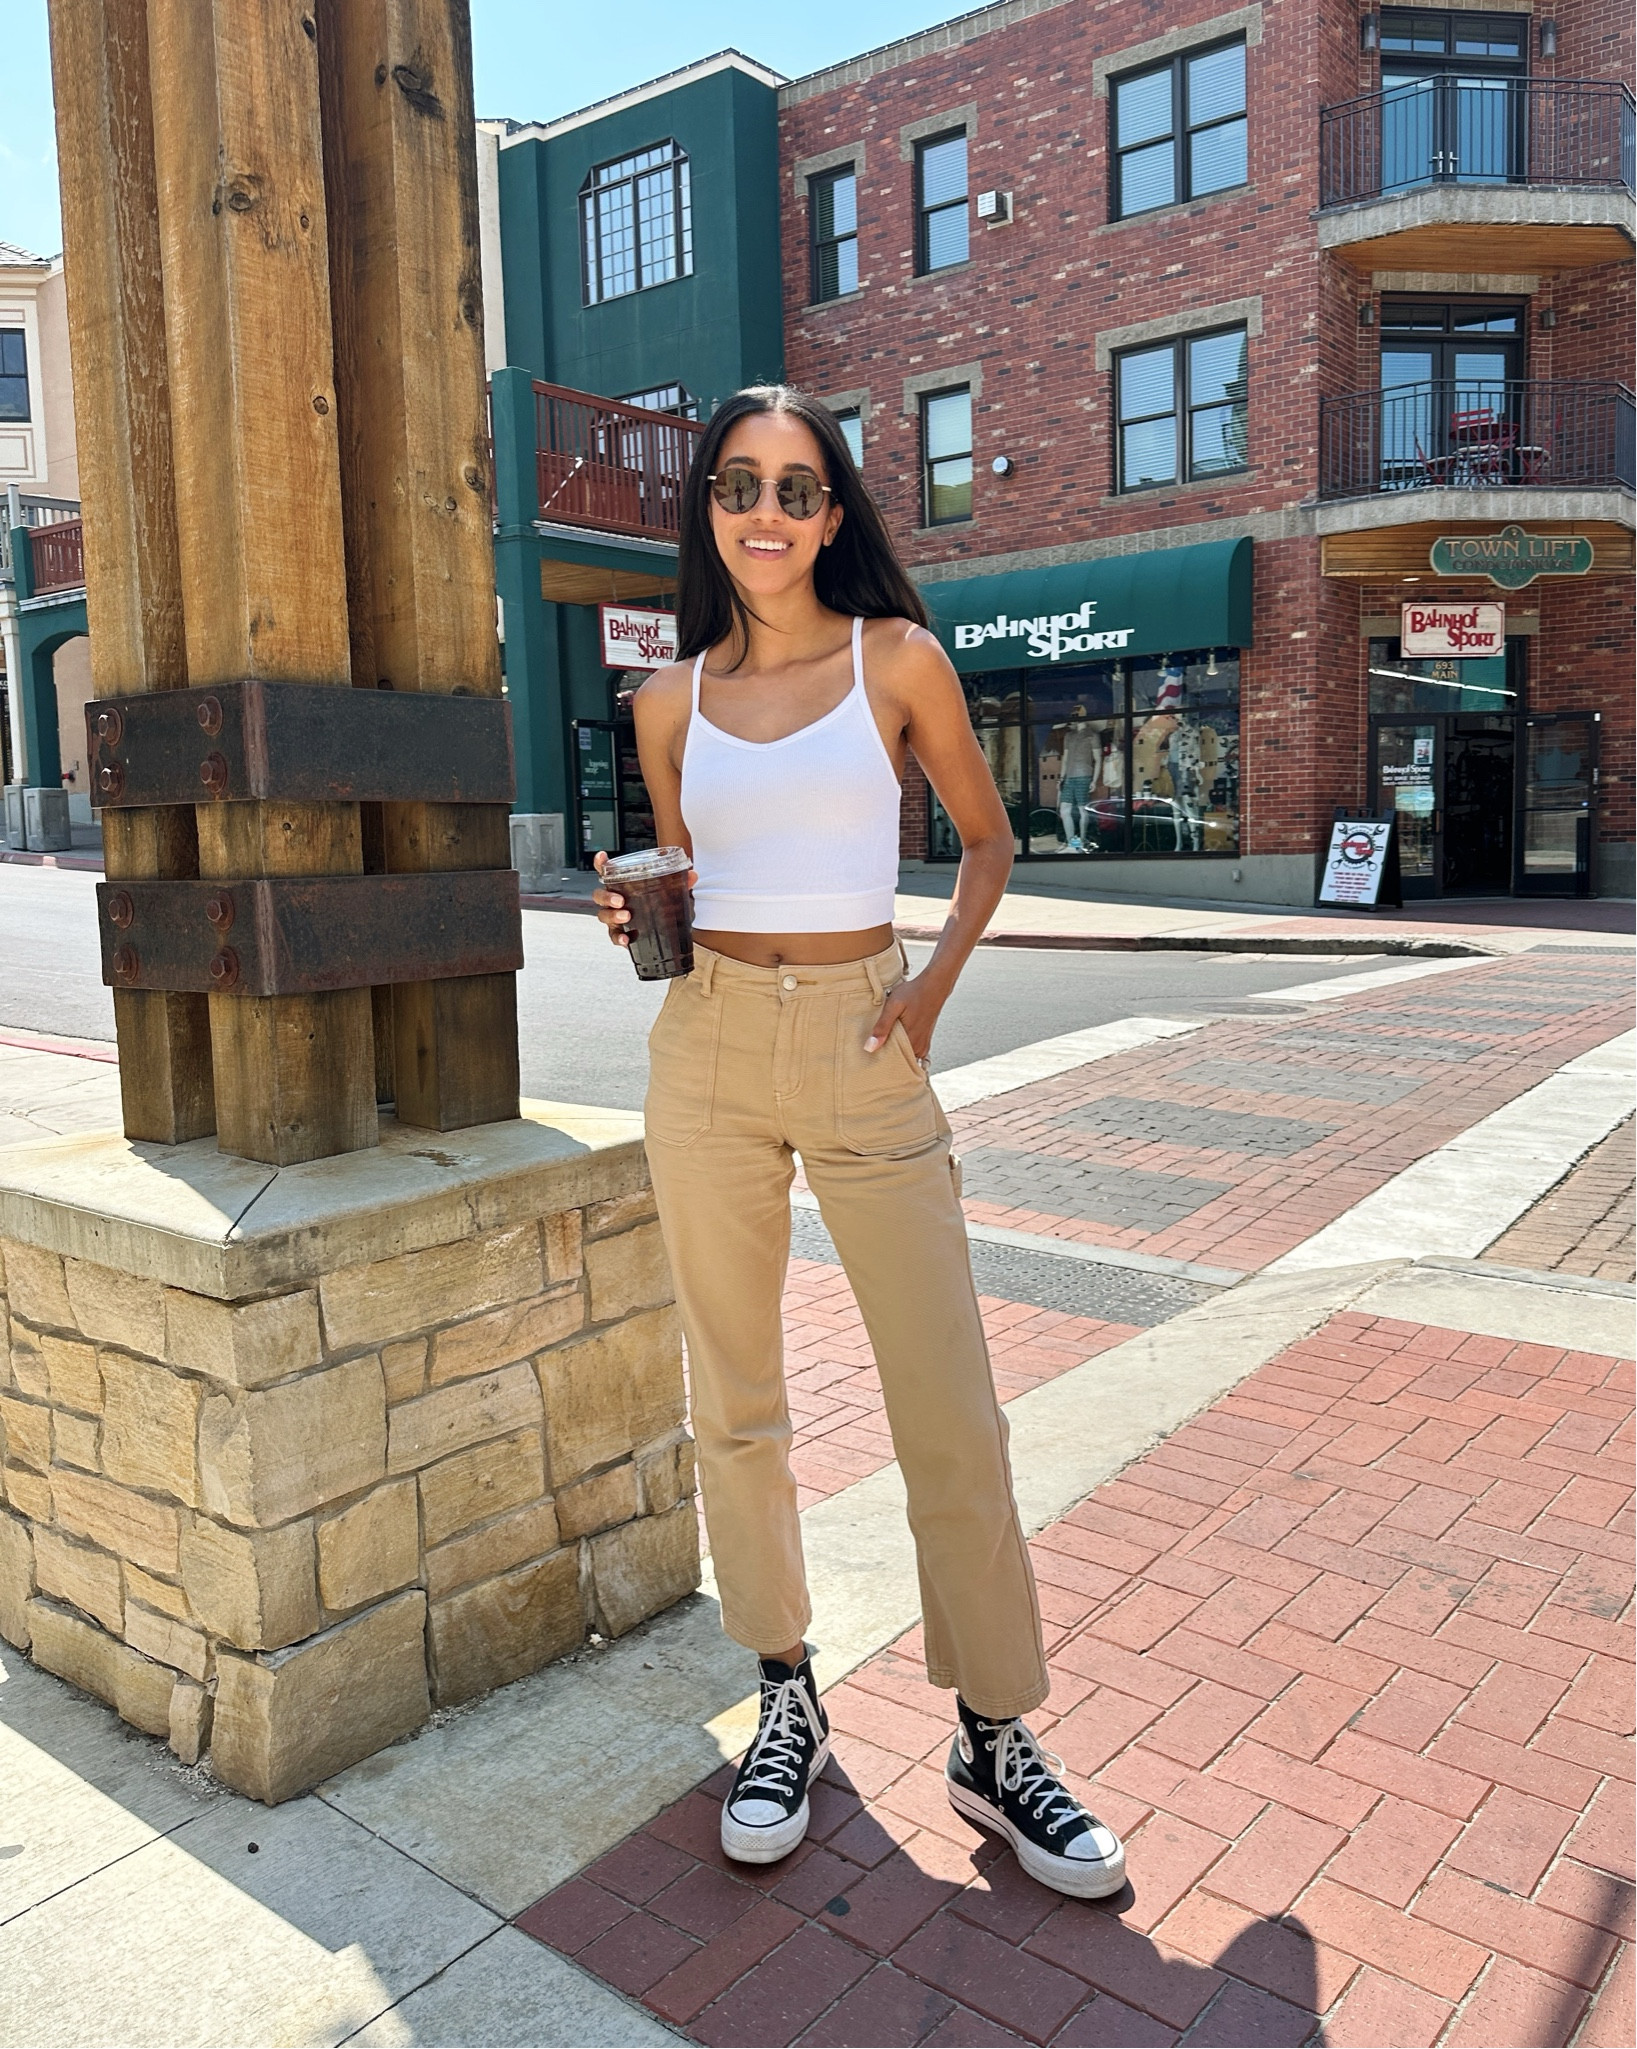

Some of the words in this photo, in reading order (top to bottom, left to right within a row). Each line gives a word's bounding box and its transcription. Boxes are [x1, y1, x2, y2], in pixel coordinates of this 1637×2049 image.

[1445, 540, 1520, 557] TOWN
[1529, 540, 1581, 557] LIFT
[1453, 559, 1574, 570] CONDOMINIUMS
[1435, 661, 1454, 670] 693
[1431, 671, 1458, 679] MAIN
